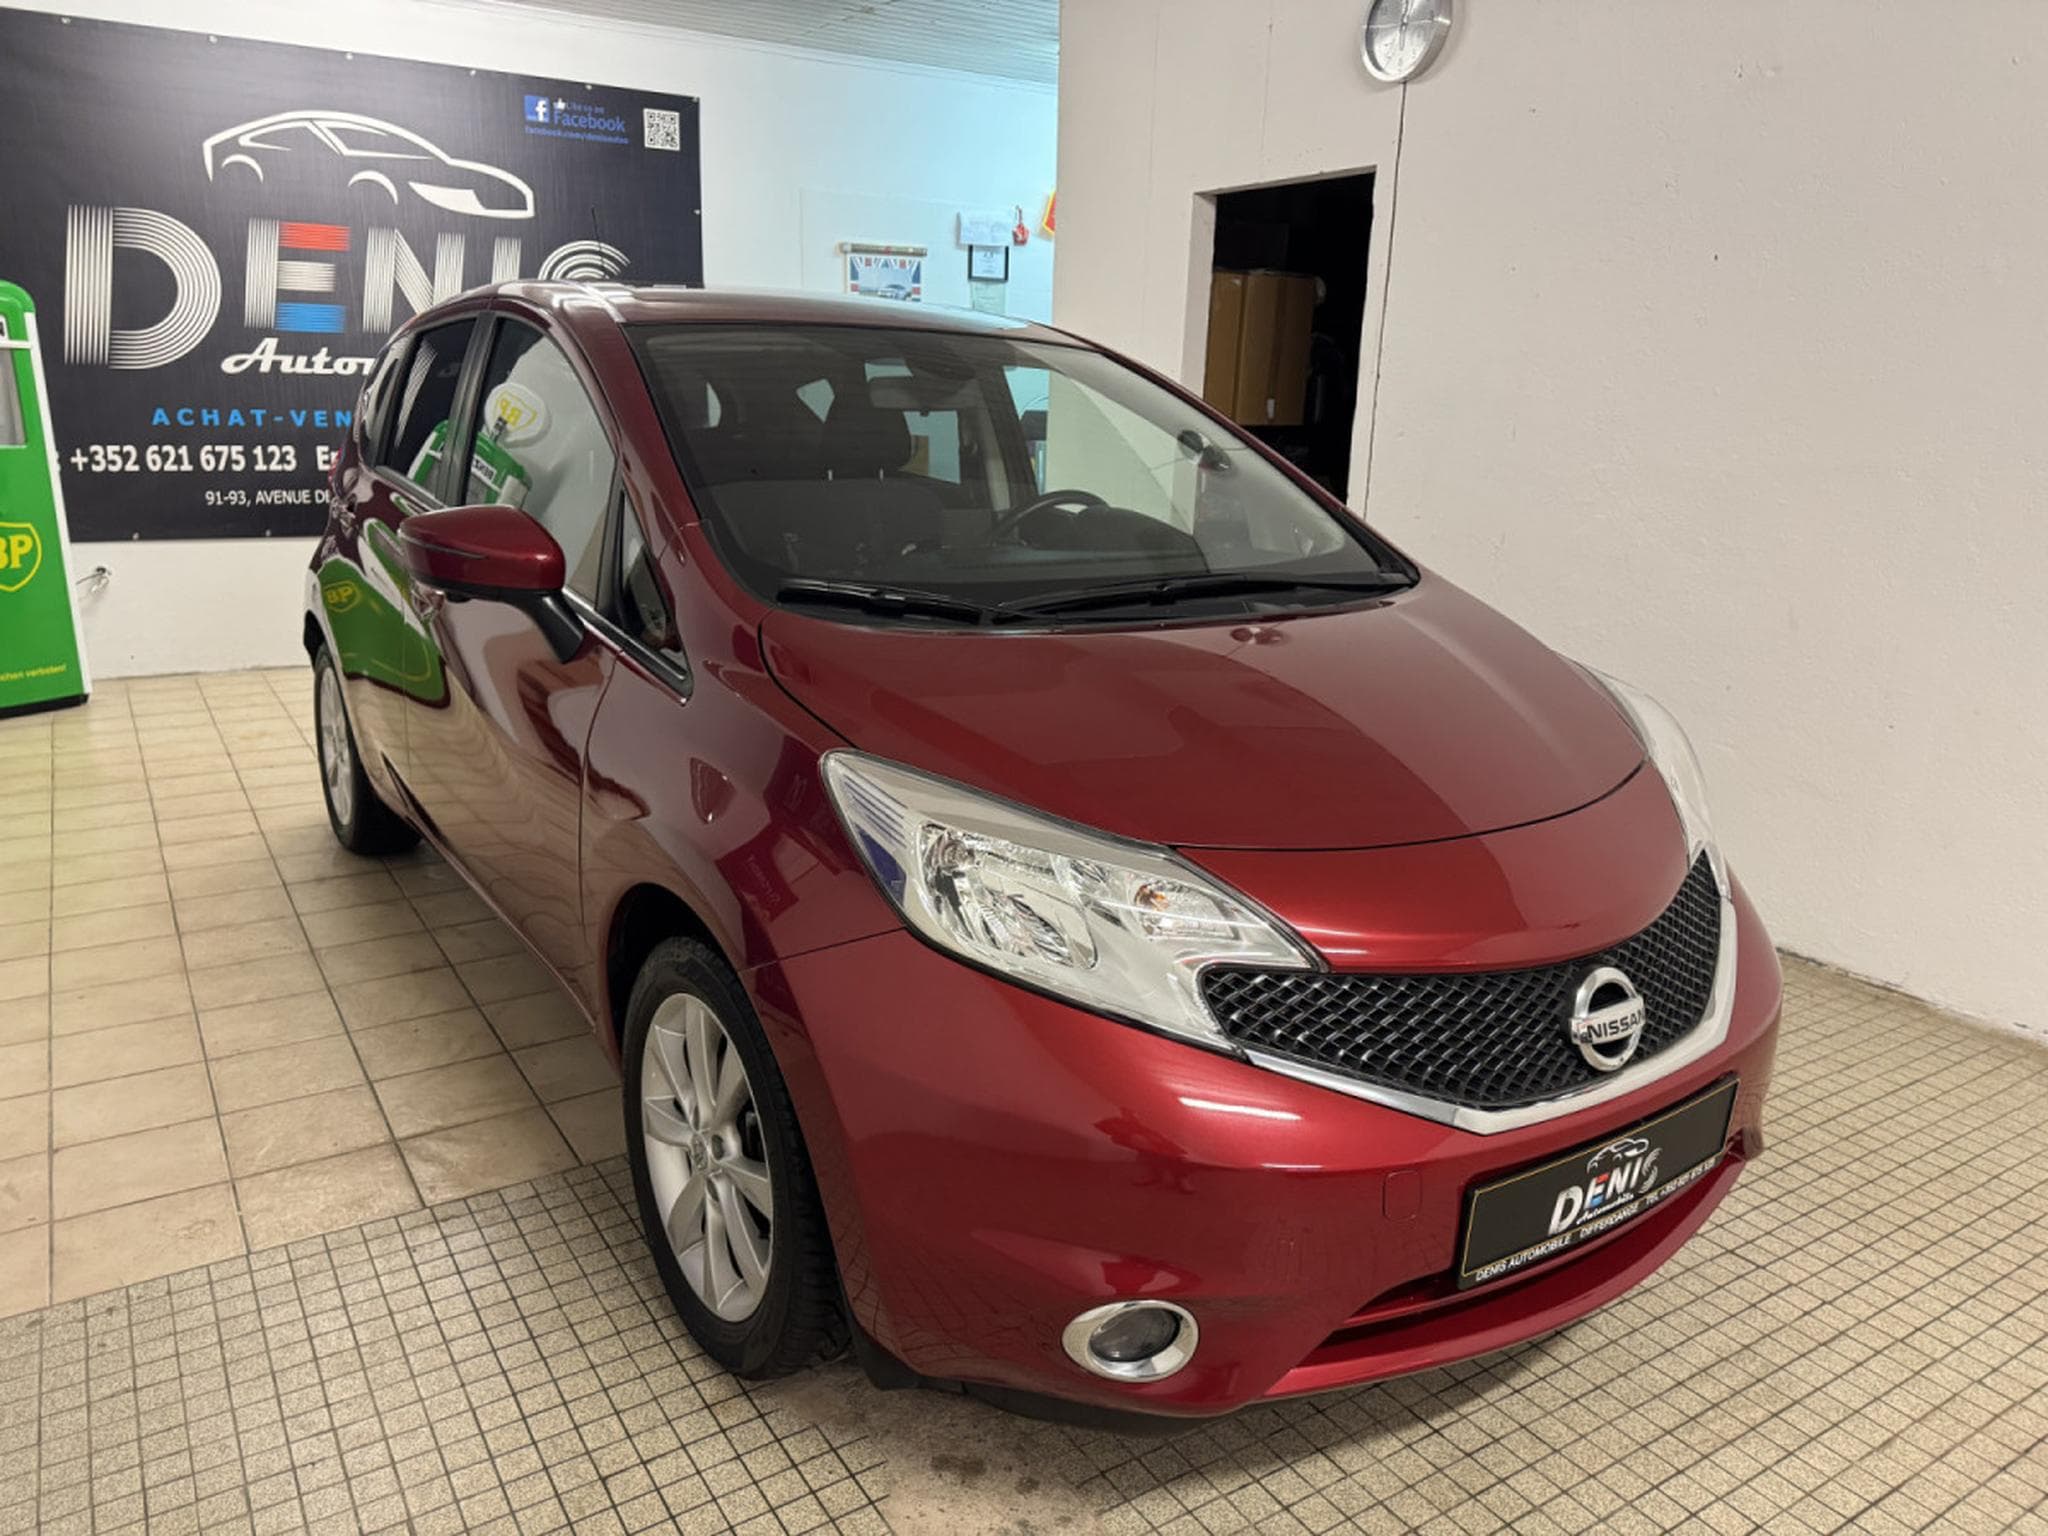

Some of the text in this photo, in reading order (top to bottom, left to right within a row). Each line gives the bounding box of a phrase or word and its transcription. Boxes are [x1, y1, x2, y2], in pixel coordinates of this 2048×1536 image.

[553, 110, 625, 132] Facebook
[70, 445, 140, 473] +352
[145, 445, 194, 473] 621
[200, 445, 246, 473] 675
[252, 446, 297, 473] 123
[205, 489, 330, 508] 91-93, AVENUE D
[1548, 1148, 1662, 1236] DENIS
[1475, 1260, 1506, 1282] DENIS
[1507, 1234, 1571, 1269] AUTOMOBILE
